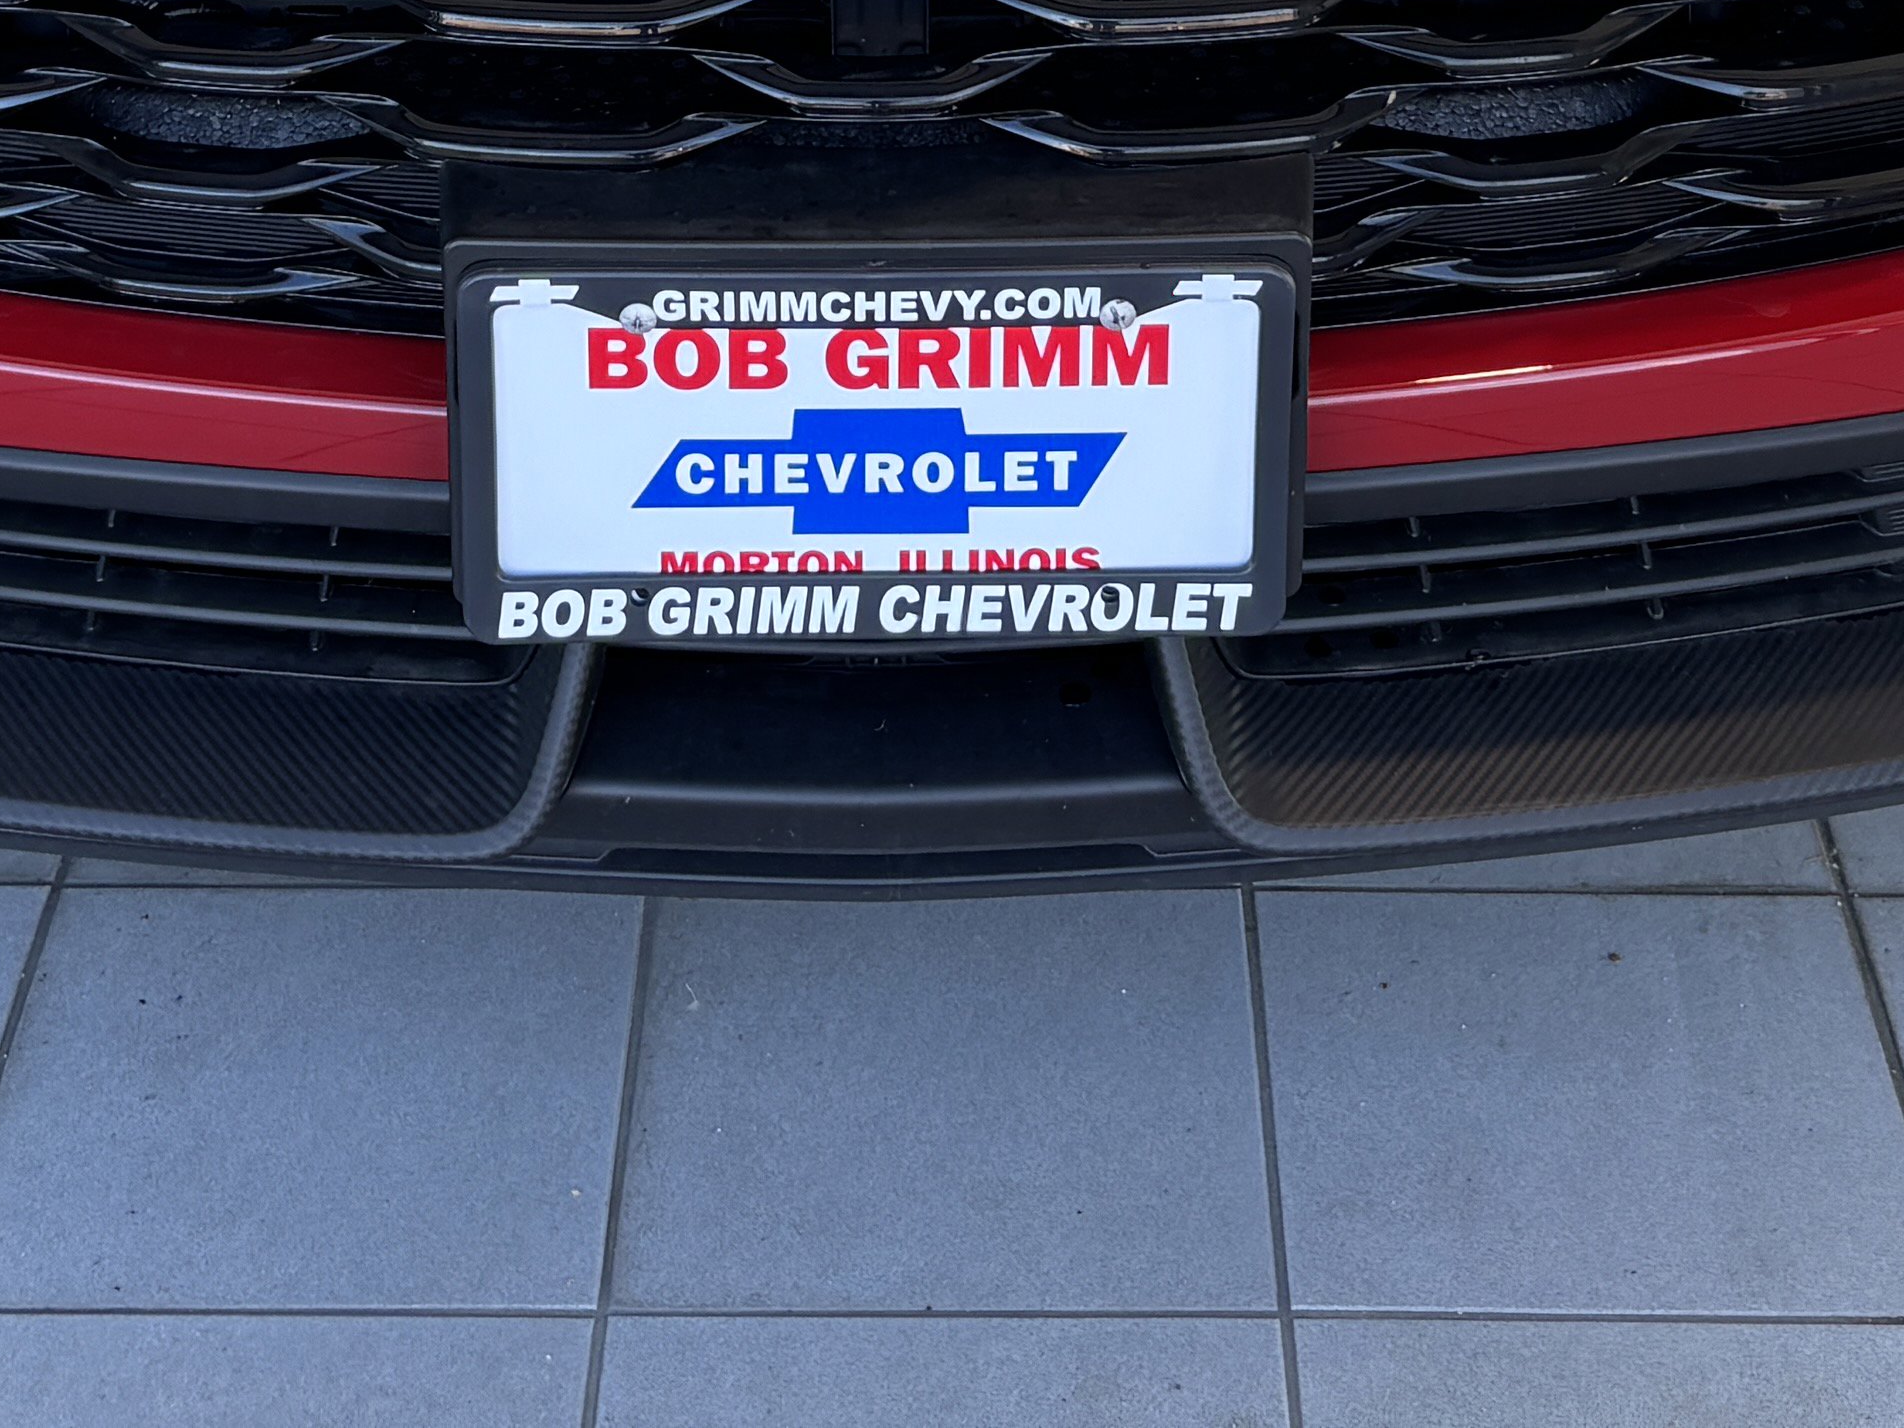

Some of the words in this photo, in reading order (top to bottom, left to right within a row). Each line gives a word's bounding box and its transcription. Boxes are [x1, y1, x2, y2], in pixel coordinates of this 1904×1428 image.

[652, 286, 1102, 323] GRIMMCHEVY.COM
[588, 327, 789, 390] BOB
[825, 323, 1170, 390] GRIMM
[675, 449, 1083, 495] CHEVROLET
[497, 588, 628, 640] BOB
[647, 585, 860, 636] GRIMM
[879, 582, 1253, 635] CHEVROLET
